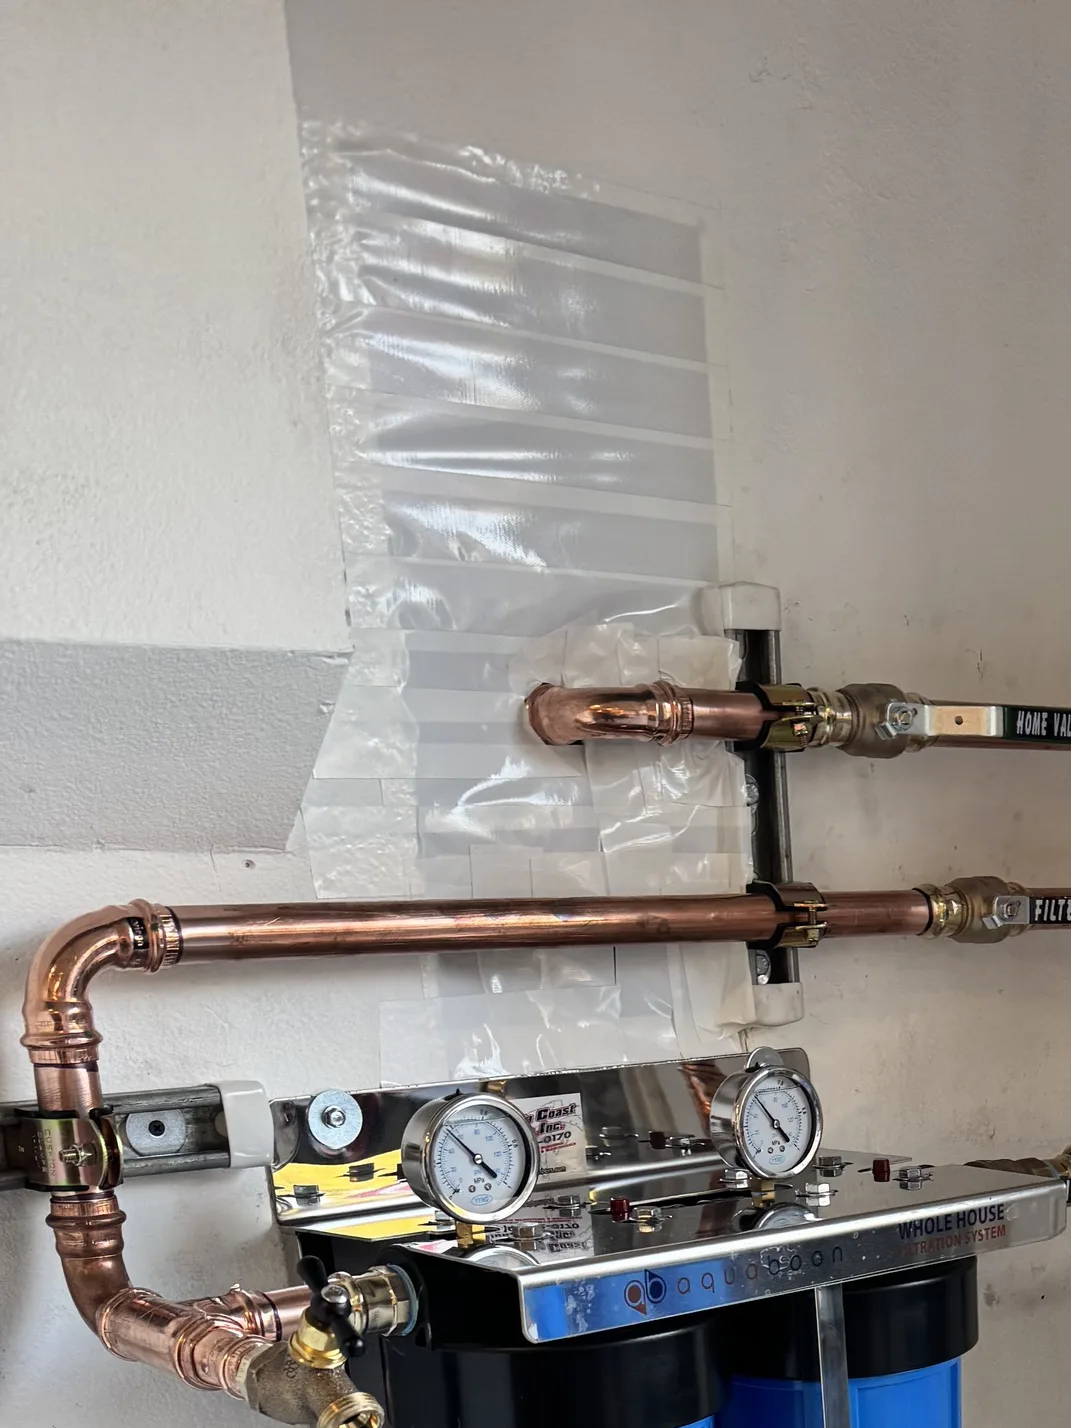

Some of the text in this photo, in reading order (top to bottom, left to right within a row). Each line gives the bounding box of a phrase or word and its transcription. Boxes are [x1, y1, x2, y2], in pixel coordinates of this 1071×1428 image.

[1016, 710, 1048, 736] HOME
[536, 1102, 577, 1121] Coast
[898, 1203, 1005, 1240] WHOLE HOUSE
[965, 1224, 1006, 1245] SYSTEM
[677, 1245, 843, 1295] aquaboon
